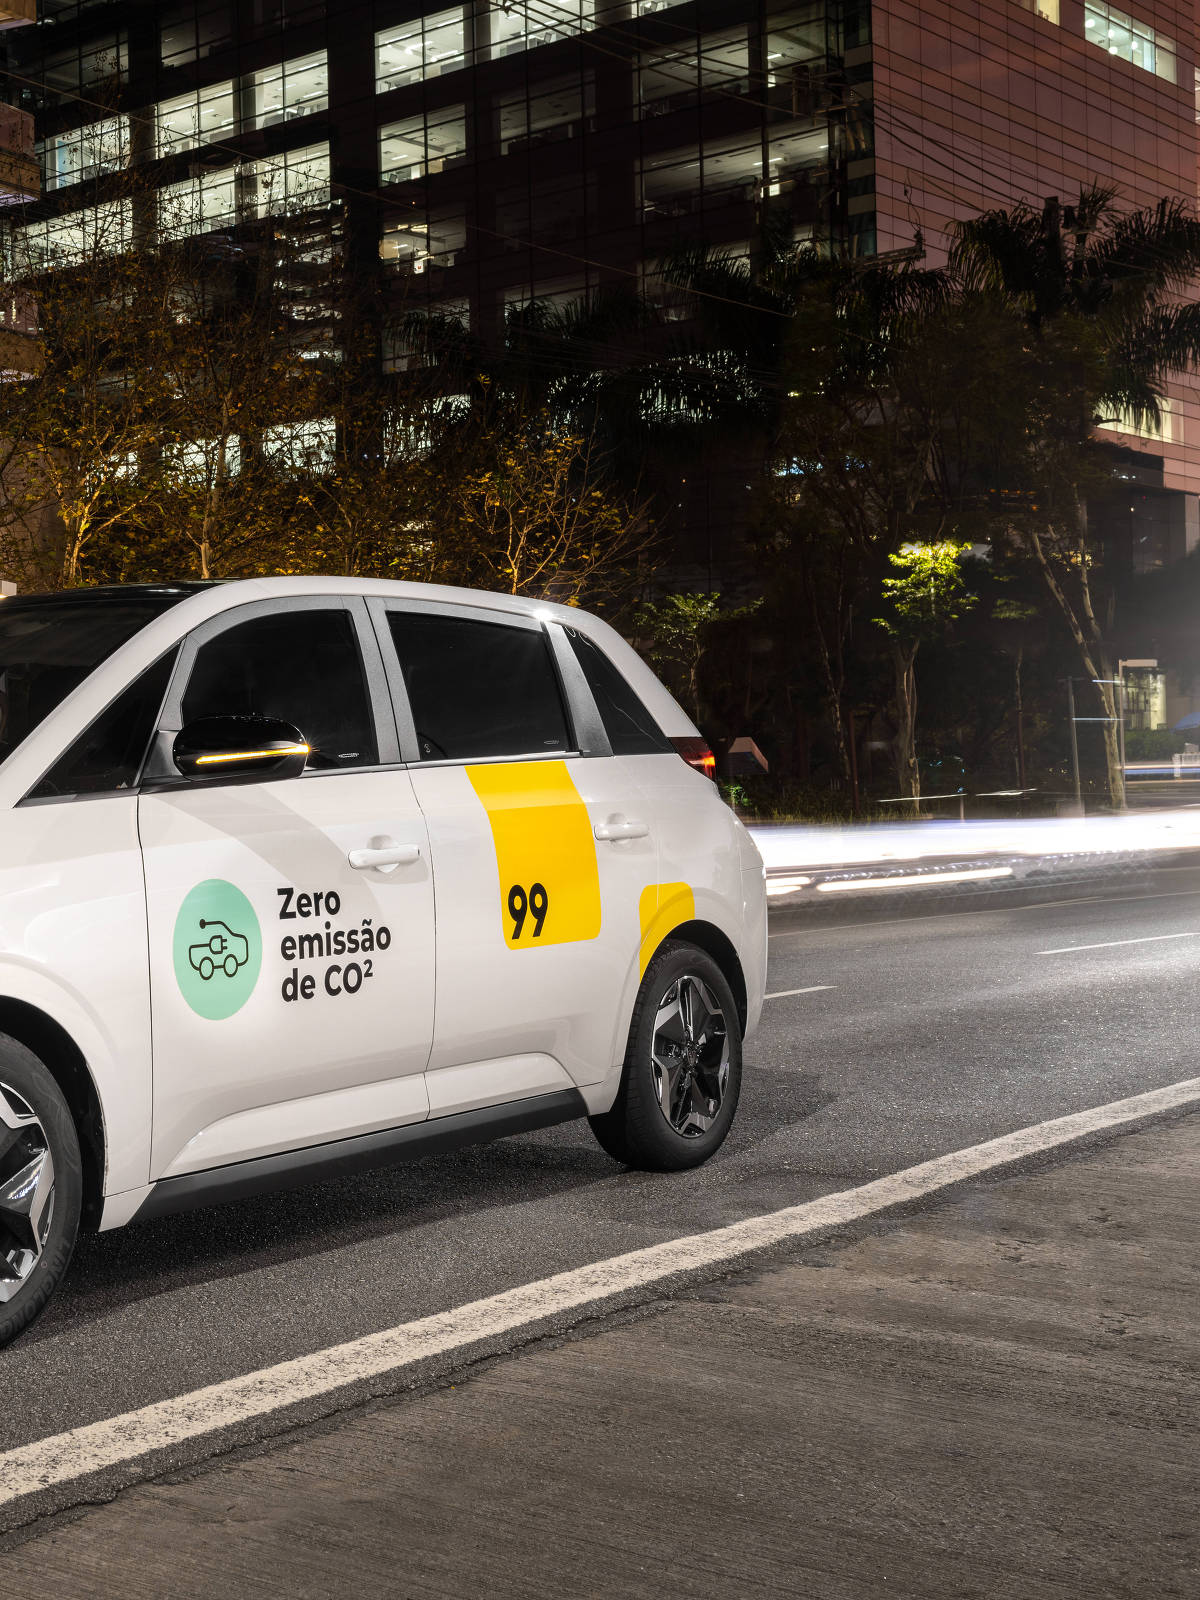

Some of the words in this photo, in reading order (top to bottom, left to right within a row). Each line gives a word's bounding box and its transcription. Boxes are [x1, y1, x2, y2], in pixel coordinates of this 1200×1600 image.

[277, 887, 341, 920] Zero
[508, 882, 549, 940] 99
[280, 919, 392, 961] emissão
[281, 967, 316, 1003] de
